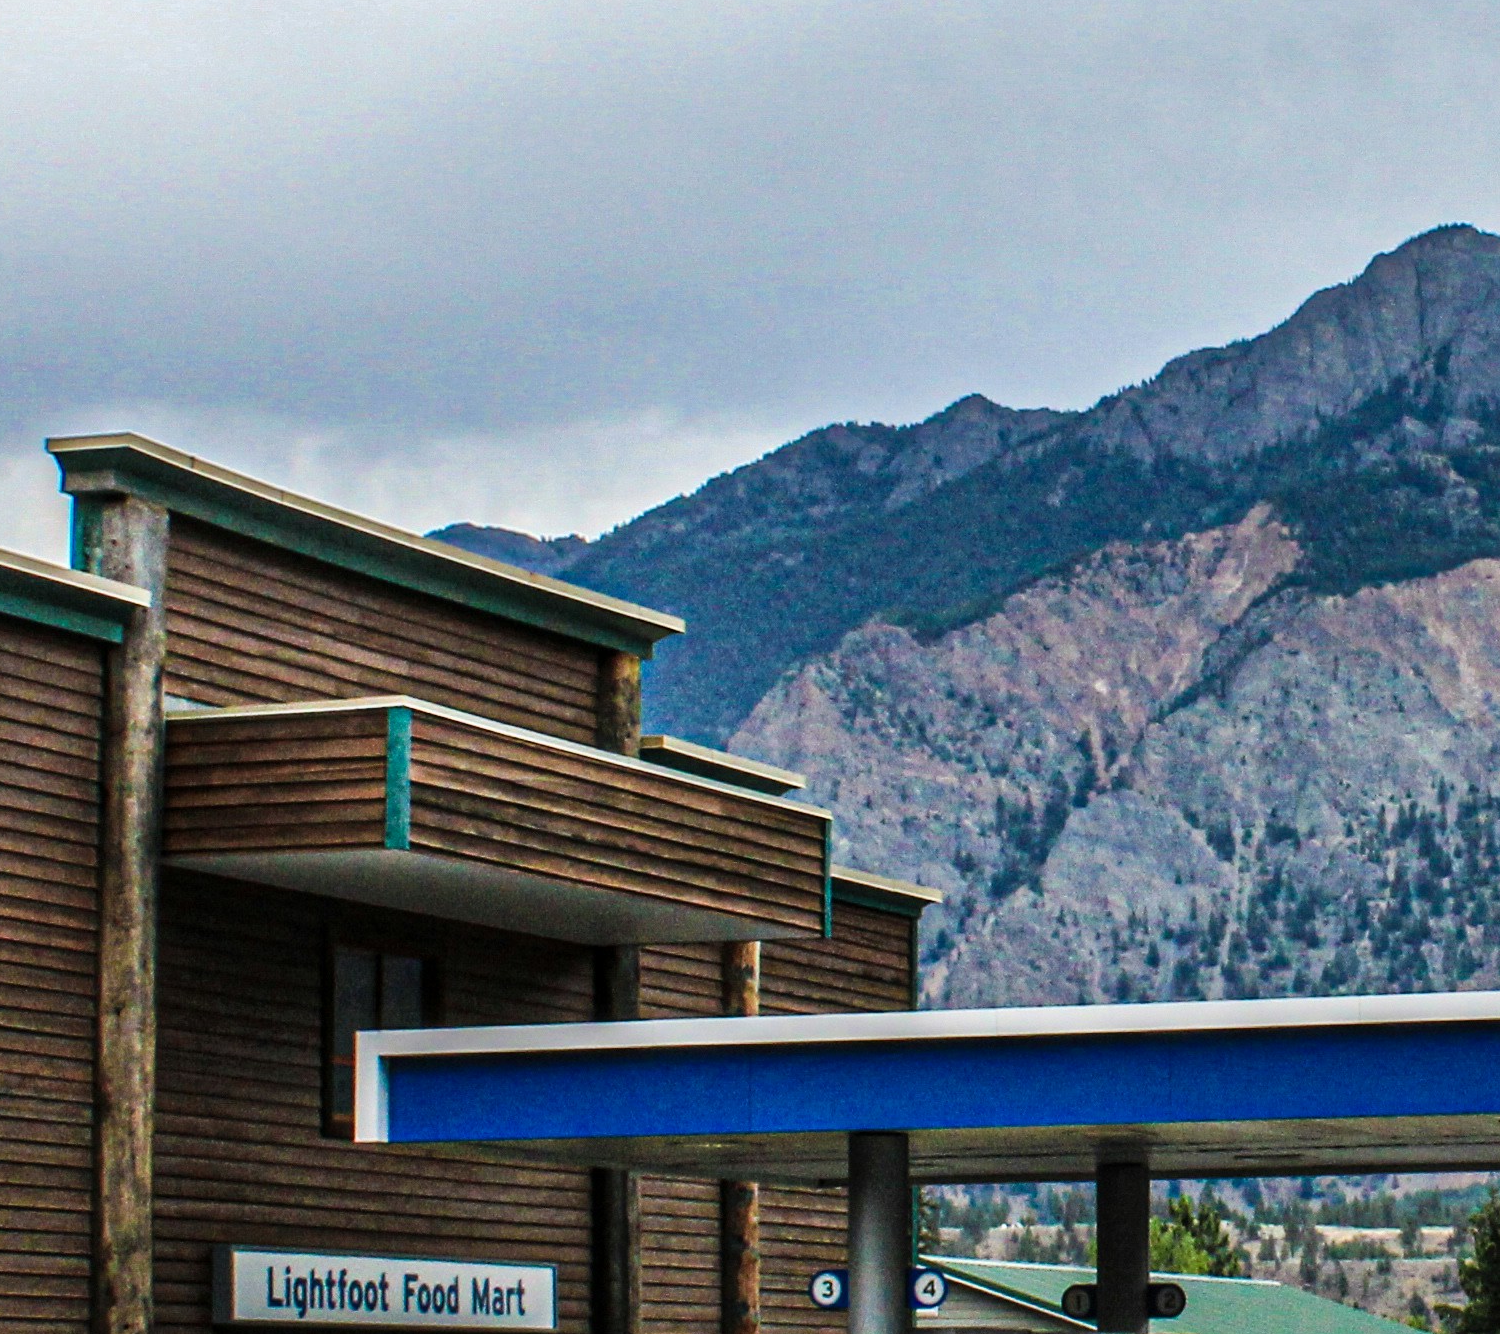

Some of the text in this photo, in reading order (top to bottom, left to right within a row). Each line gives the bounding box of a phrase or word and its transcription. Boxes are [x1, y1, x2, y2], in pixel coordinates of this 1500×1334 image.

[266, 1266, 526, 1318] Lightfoot Food Mart
[822, 1280, 834, 1298] 3
[923, 1279, 936, 1297] 4
